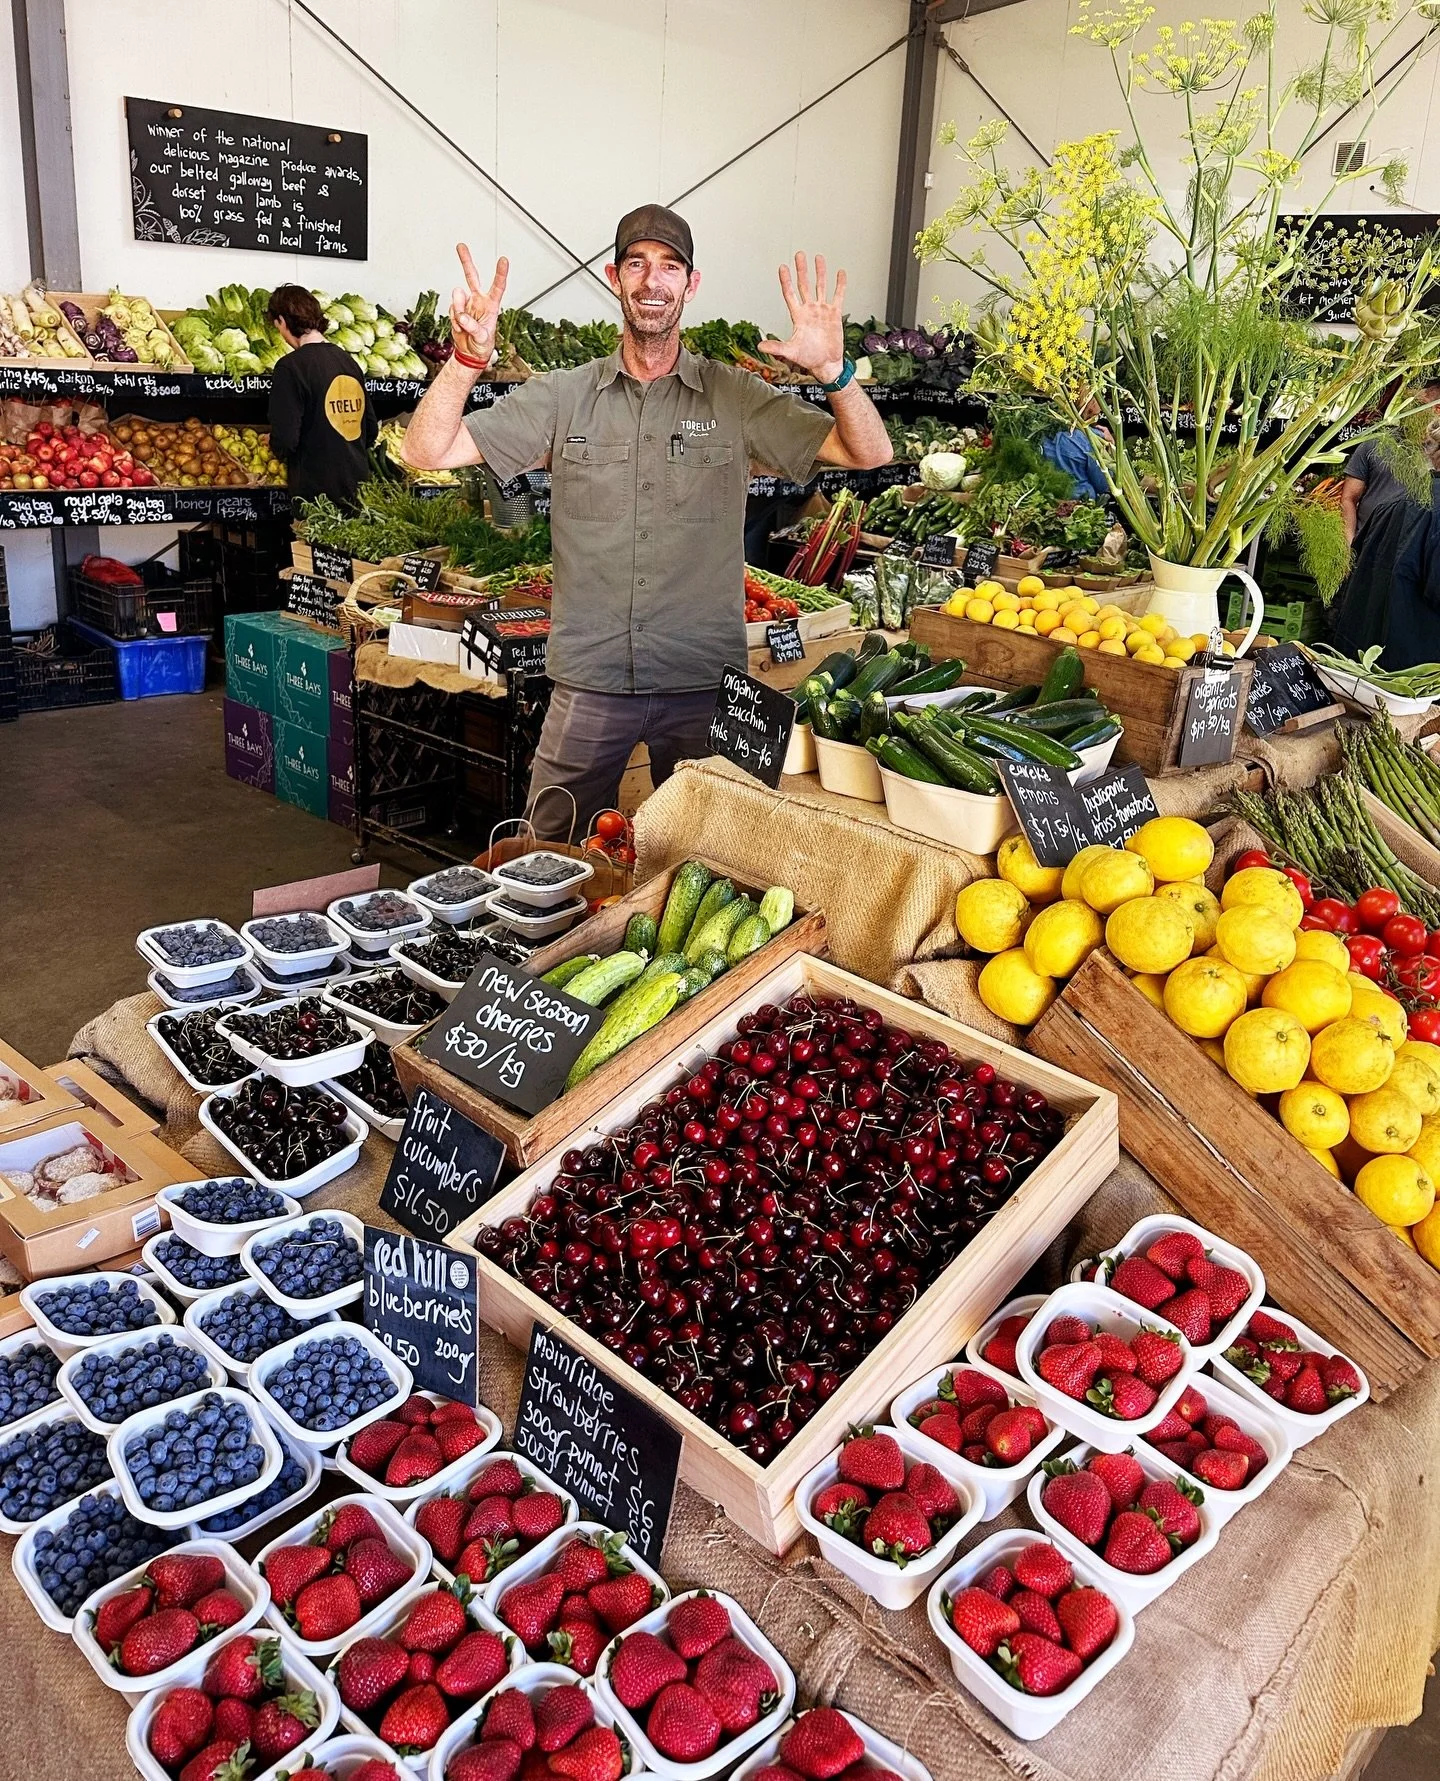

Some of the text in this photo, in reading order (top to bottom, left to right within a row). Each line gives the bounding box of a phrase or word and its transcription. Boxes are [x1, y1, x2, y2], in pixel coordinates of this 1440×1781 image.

[193, 128, 207, 142] of
[215, 129, 235, 147] the
[242, 135, 291, 155] national
[164, 143, 363, 186] delicious magazine produce awards,
[150, 162, 172, 175] our
[180, 164, 218, 182] belted
[229, 171, 273, 192] galloway
[282, 178, 306, 196] beef
[172, 183, 304, 213] dorset down lamb is
[179, 204, 202, 223] 100%
[214, 209, 245, 225] grass
[255, 210, 272, 227] fed
[296, 215, 341, 235] finished
[257, 231, 348, 254] on local farms
[1299, 292, 1314, 305] let
[1325, 308, 1352, 322] guide
[57, 371, 95, 385] daikon
[114, 374, 157, 387] kohl rabi
[680, 419, 717, 432] TORELLO
[8, 498, 54, 516] 2kg bag
[63, 492, 123, 514] royal gala
[70, 507, 122, 525] $4.50/kg
[126, 497, 165, 515] 2kg bag
[175, 492, 252, 516] honey pears
[481, 608, 546, 622] CHERRIES
[234, 653, 269, 676] THREE BAYS
[511, 647, 526, 659] red
[286, 672, 322, 696] THREE BAYS
[723, 673, 763, 704] organic
[1194, 680, 1226, 710] organic
[332, 690, 352, 709] THREE
[1205, 685, 1238, 718] apricots
[727, 704, 770, 734] zucchini
[1190, 713, 1231, 742] $19.50/kg
[227, 732, 263, 757] THREE BAYS
[284, 754, 320, 780] THREE BAYS
[1008, 763, 1052, 783] eureka
[331, 774, 351, 794] THREE
[1013, 778, 1060, 806] lemons
[1081, 776, 1129, 822] hydroponic
[1090, 815, 1117, 841] truss
[478, 965, 590, 1037] new season
[475, 999, 557, 1053] cherries
[410, 1090, 452, 1143] fruit
[402, 1136, 484, 1203] cucumbers
[373, 1236, 448, 1292] red hill
[434, 1337, 475, 1385] 200gr
[528, 1366, 640, 1476] strawberries
[522, 1401, 571, 1451] 300gr
[568, 1441, 620, 1492] punnet
[517, 1428, 567, 1475] 500gr
[564, 1464, 615, 1518] punnet
